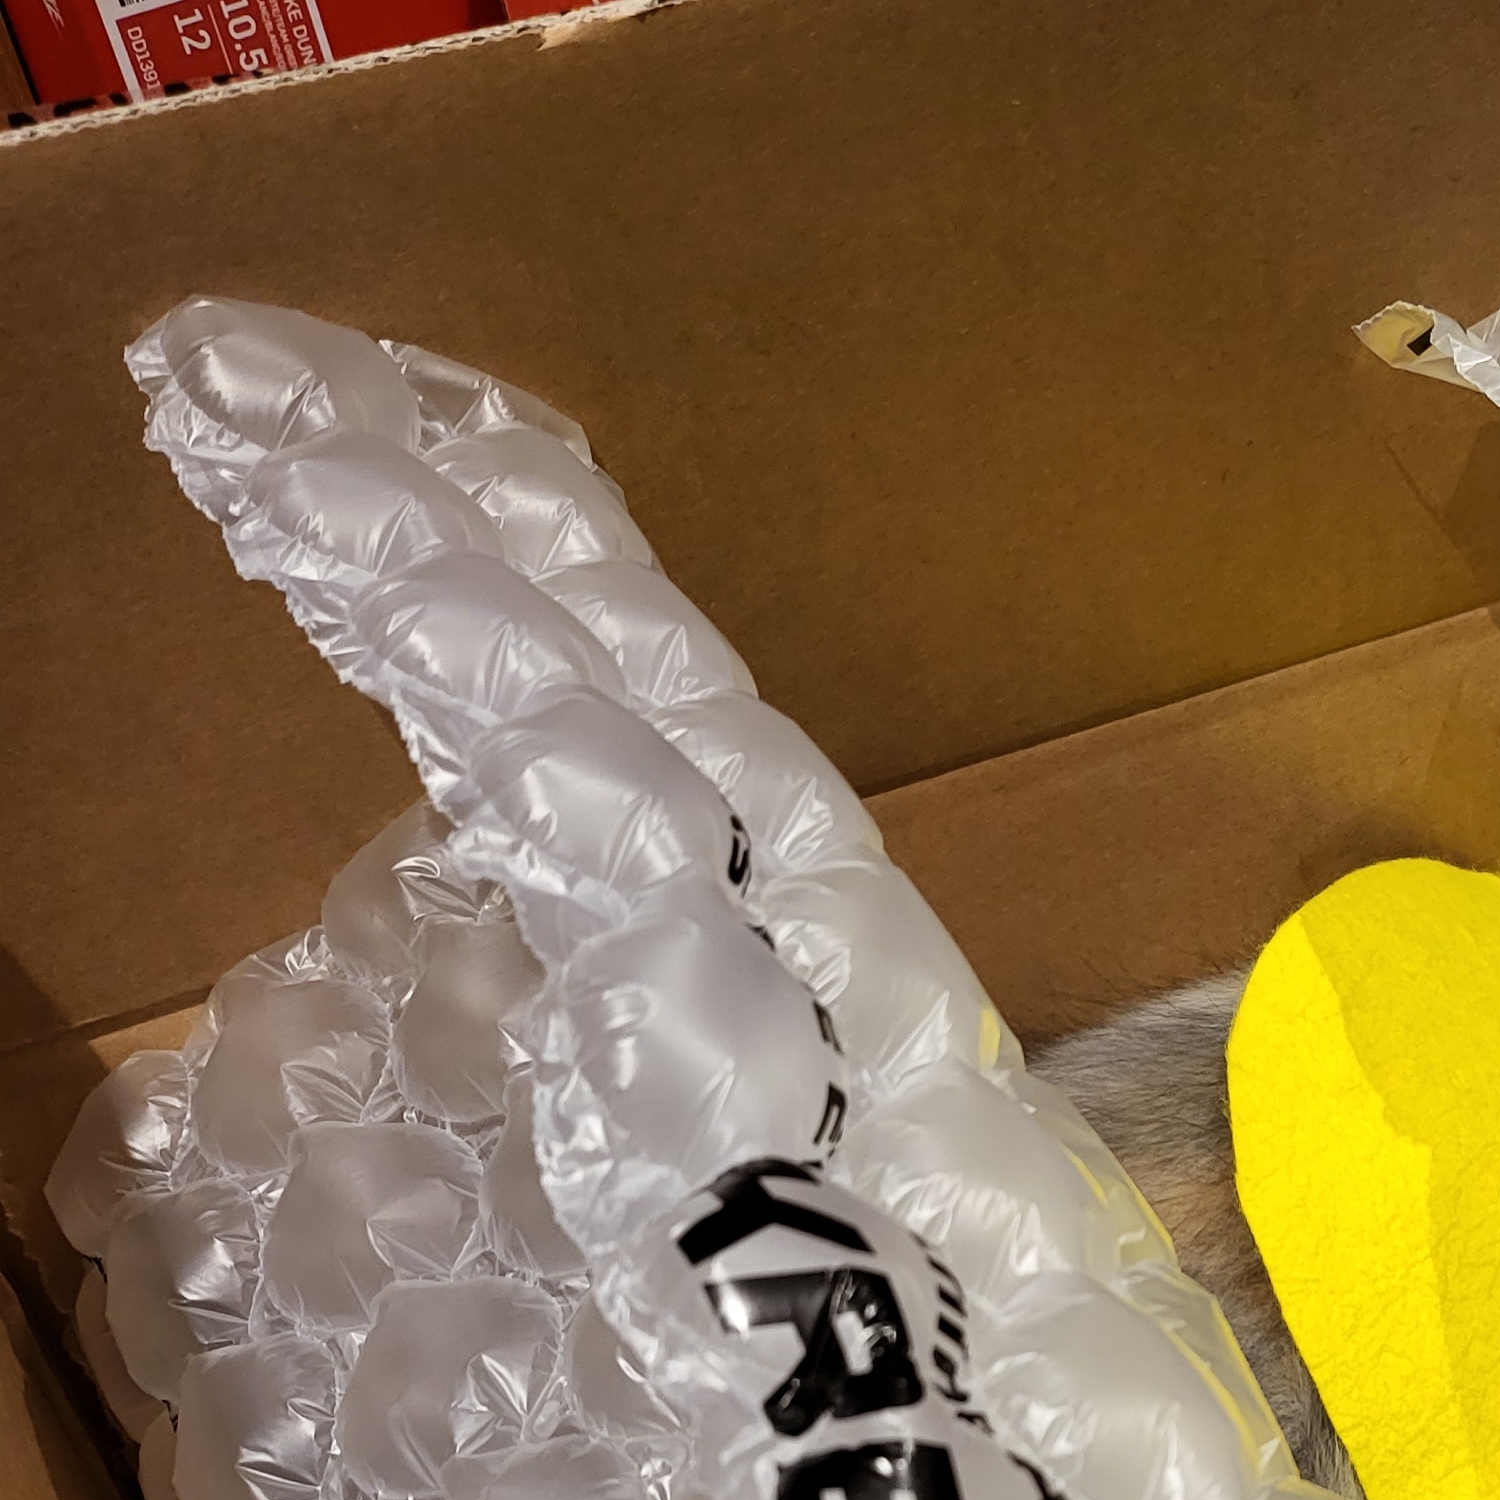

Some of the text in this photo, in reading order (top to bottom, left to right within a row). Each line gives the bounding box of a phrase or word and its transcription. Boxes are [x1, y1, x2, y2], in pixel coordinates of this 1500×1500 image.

[127, 25, 162, 90] DD1391
[173, 8, 212, 56] 12
[220, 0, 269, 72] 10.5
[292, 24, 318, 67] DUN
